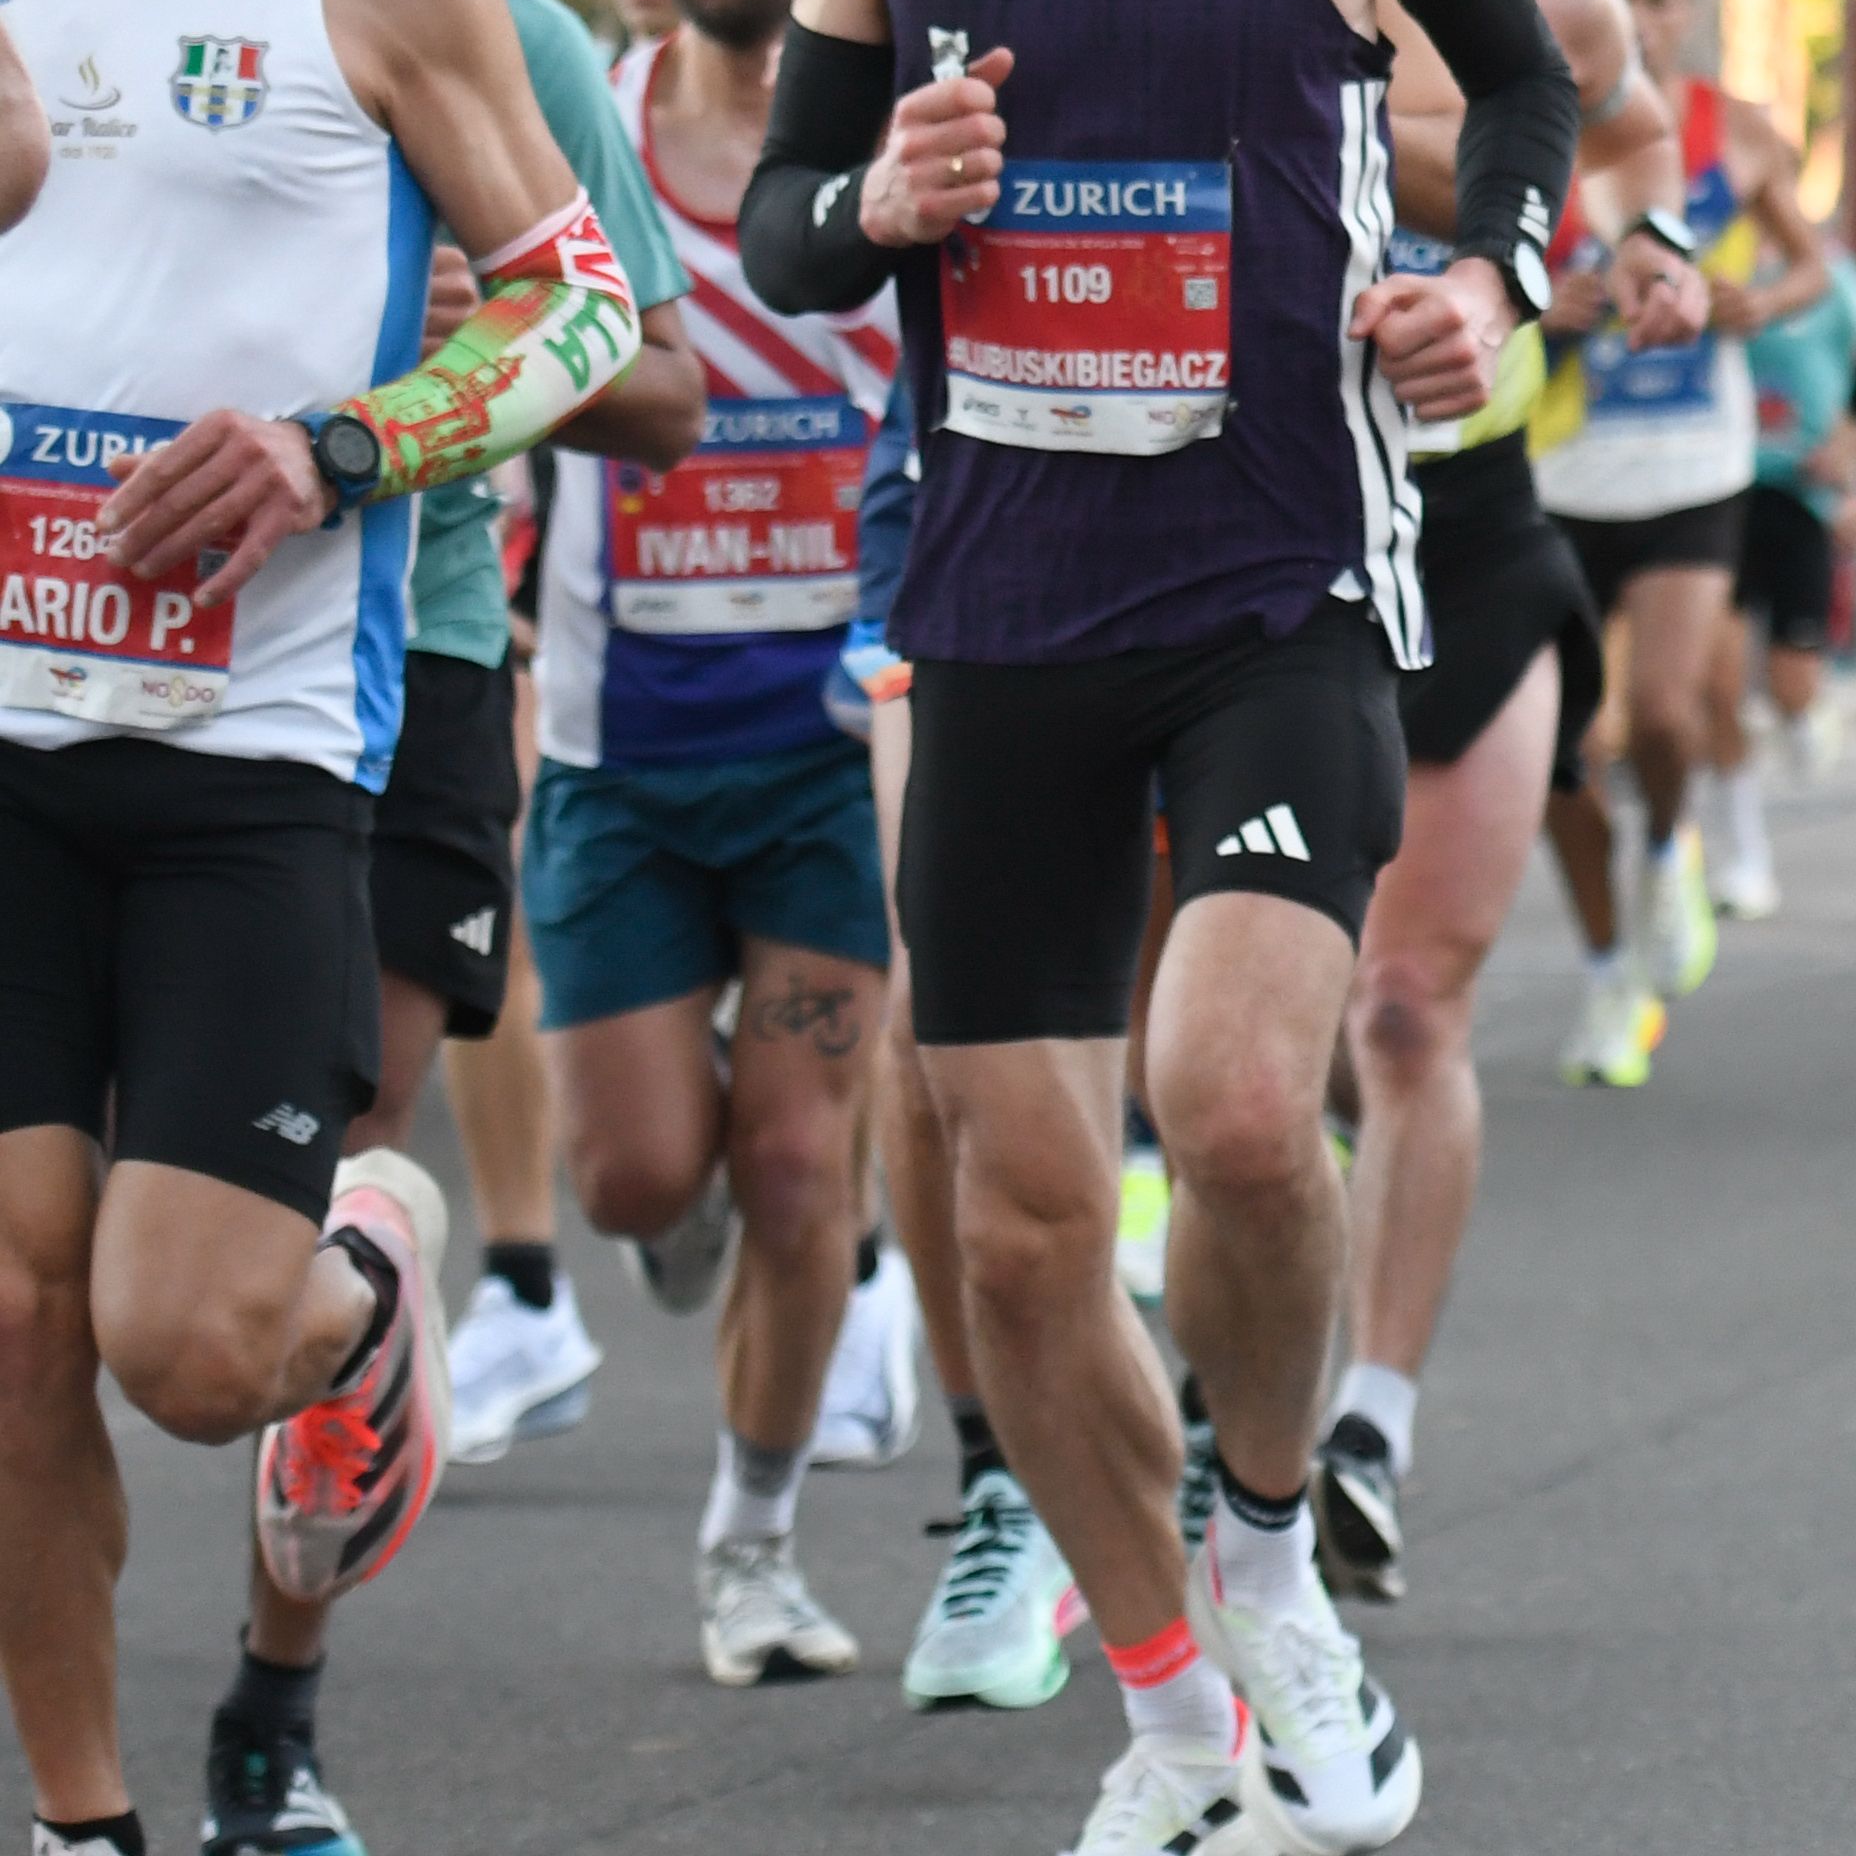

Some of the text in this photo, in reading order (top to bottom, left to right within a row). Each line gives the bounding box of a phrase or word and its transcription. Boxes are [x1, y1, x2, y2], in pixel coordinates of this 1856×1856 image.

[1012, 179, 1188, 217] ZURICH
[1020, 264, 1114, 304] 1109
[31, 425, 174, 469] ZURI
[700, 409, 840, 444] ZURICH
[637, 523, 848, 577] IVAN-NIL
[149, 591, 197, 655] P.
